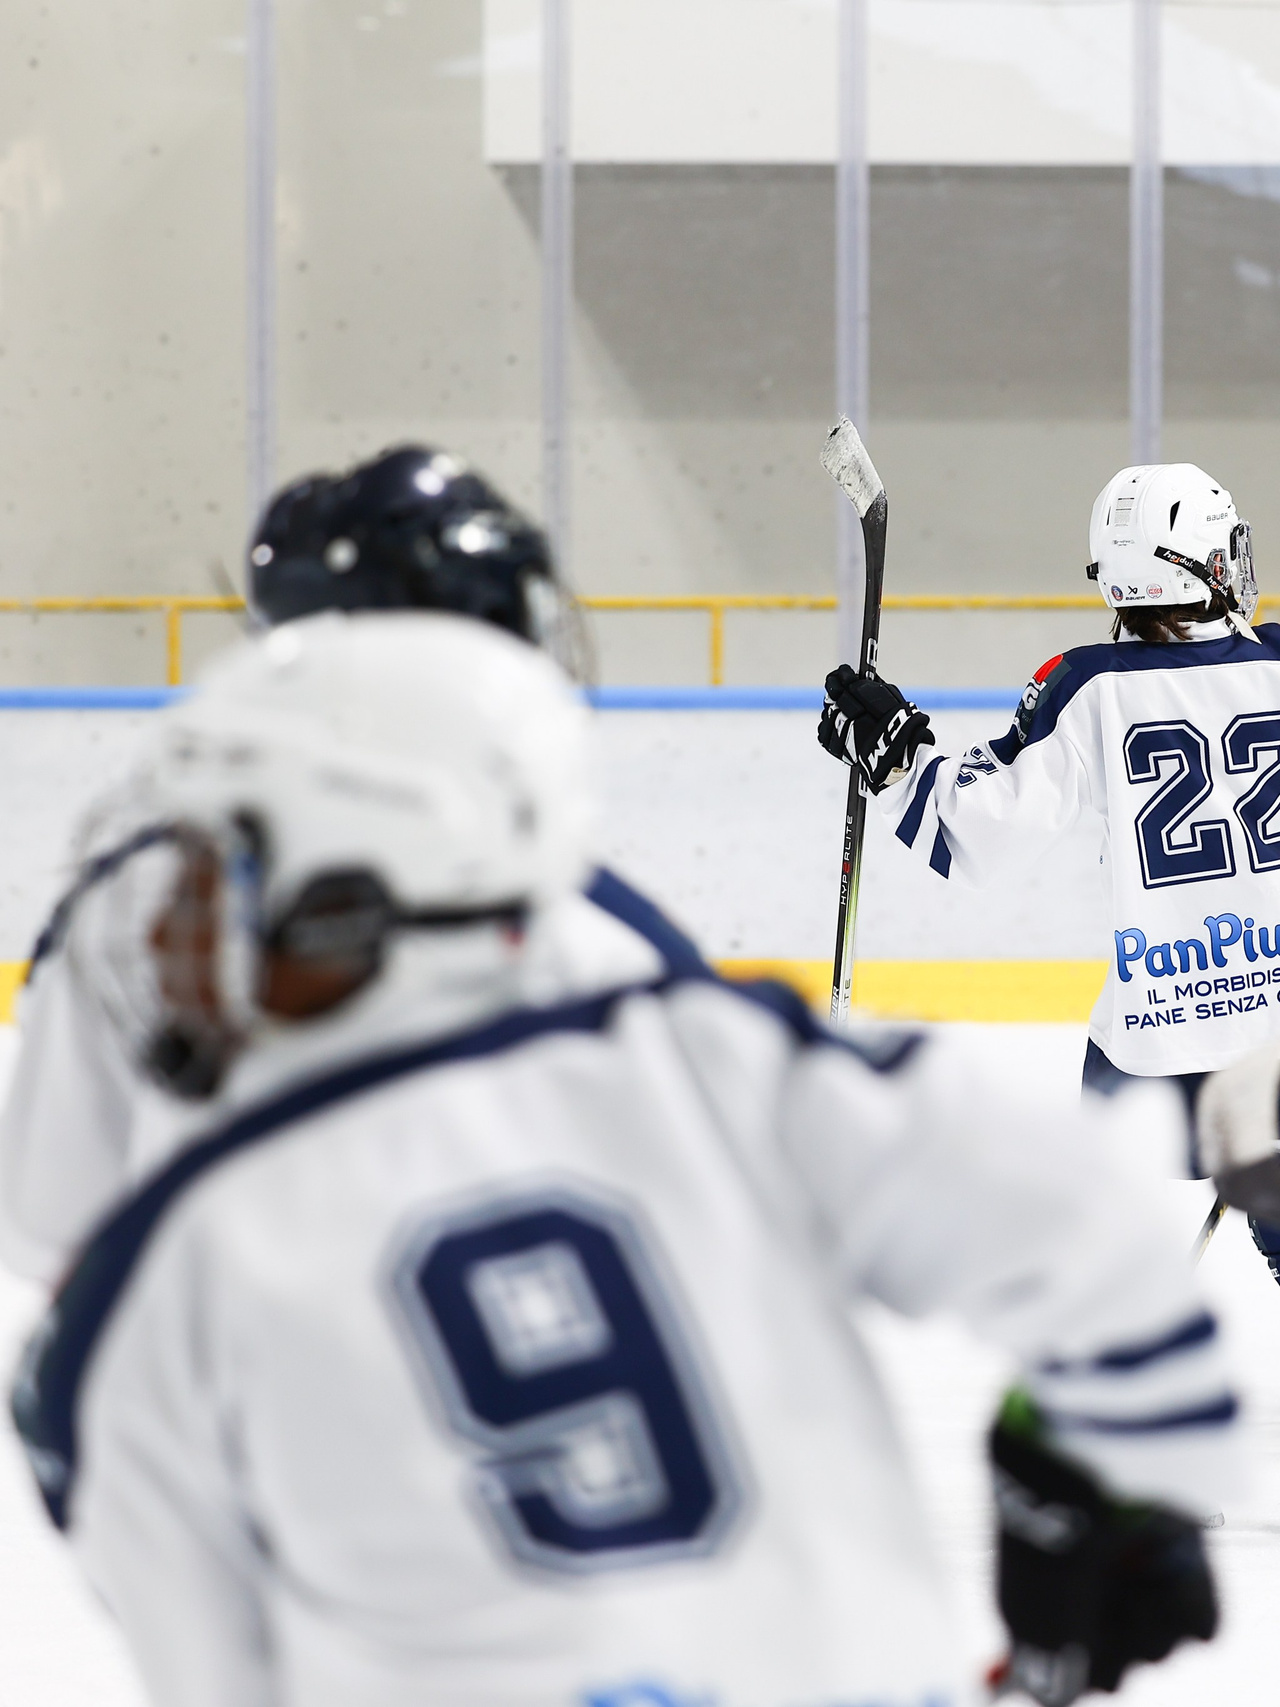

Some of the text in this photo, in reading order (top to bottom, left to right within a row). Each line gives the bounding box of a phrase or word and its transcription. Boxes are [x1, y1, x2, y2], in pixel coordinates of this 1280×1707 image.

[1206, 512, 1229, 522] BAUER
[840, 814, 854, 906] HYPERLITE
[1125, 1007, 1187, 1031] PANE
[1195, 993, 1269, 1020] SENZA
[1147, 989, 1167, 1005] IL
[385, 1175, 753, 1580] 9
